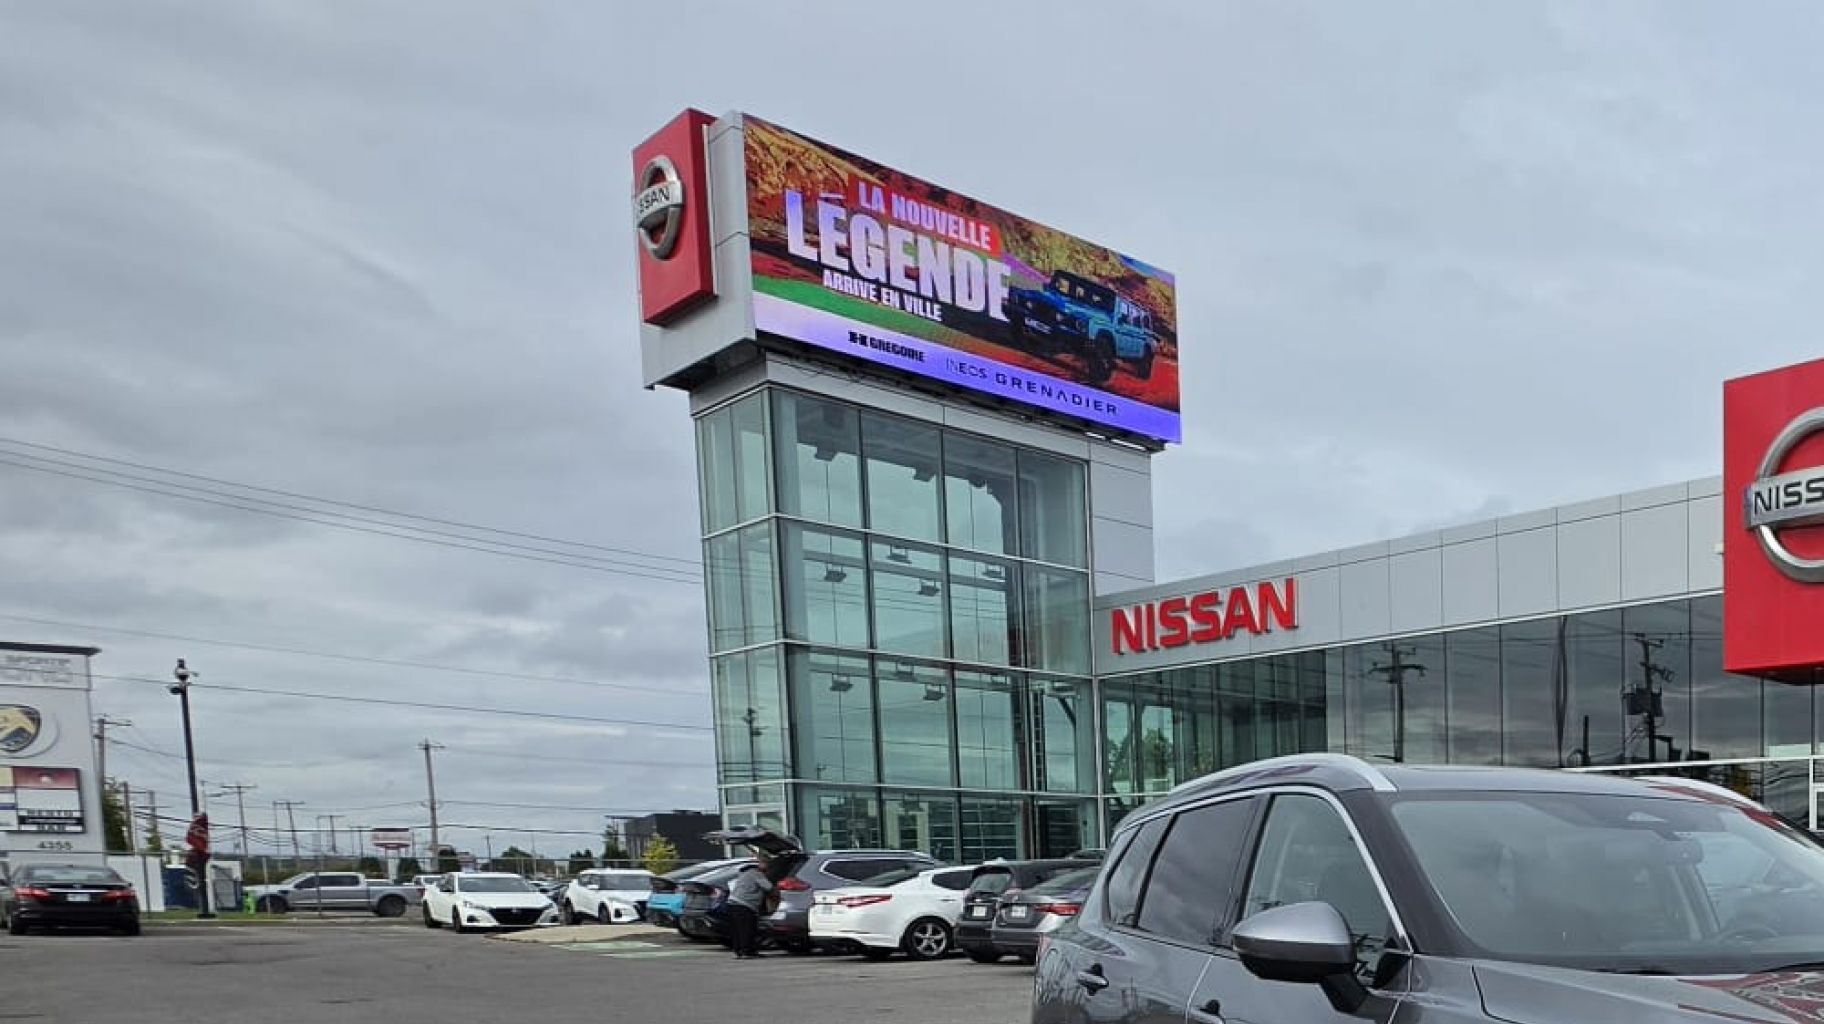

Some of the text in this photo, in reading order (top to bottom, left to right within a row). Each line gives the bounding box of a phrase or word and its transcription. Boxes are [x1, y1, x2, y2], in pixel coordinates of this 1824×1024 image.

[858, 181, 992, 250] LA NOUVELLE
[823, 269, 943, 322] ARRIVE EN VILLE
[995, 373, 1118, 415] GRENADIER
[1111, 577, 1298, 655] NISSAN
